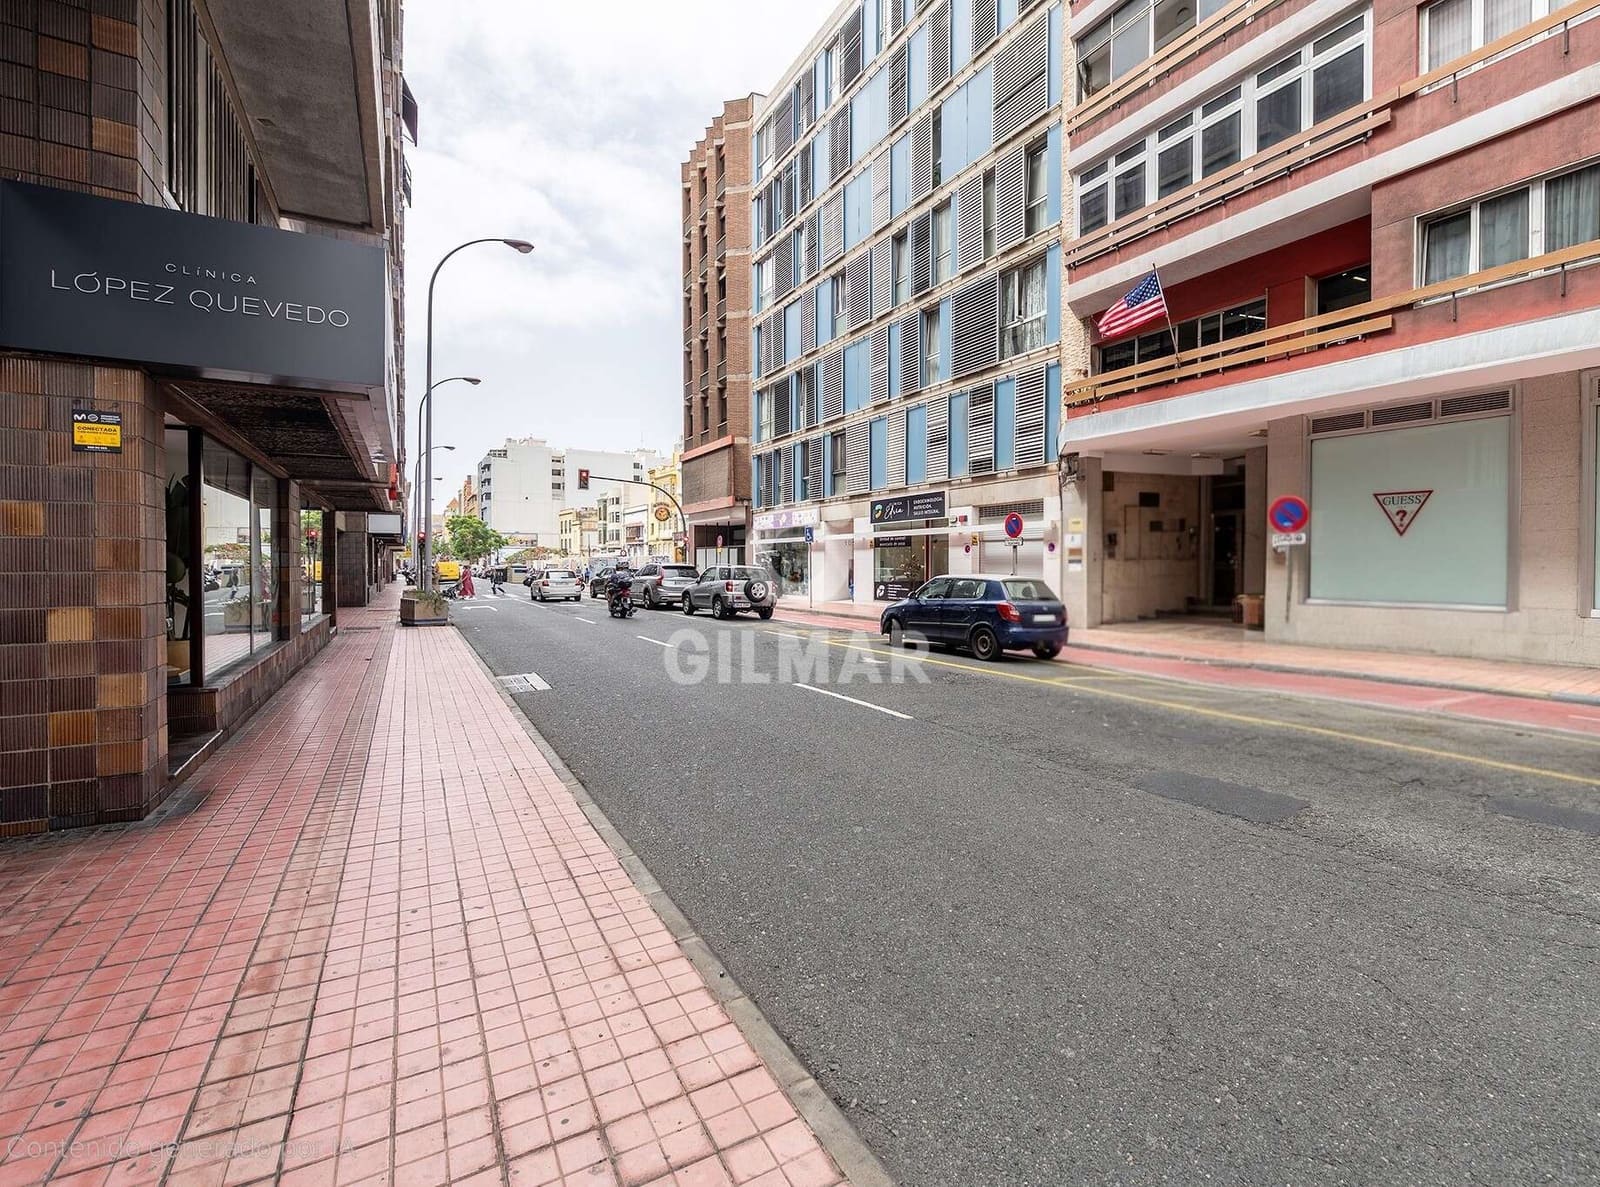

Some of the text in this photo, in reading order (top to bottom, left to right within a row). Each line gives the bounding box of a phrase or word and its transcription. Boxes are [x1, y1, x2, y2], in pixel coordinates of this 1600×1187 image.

[165, 263, 257, 285] CLÍNICA
[50, 269, 350, 328] LÓPEZ QUEVEDO
[1382, 495, 1422, 506] GUESS
